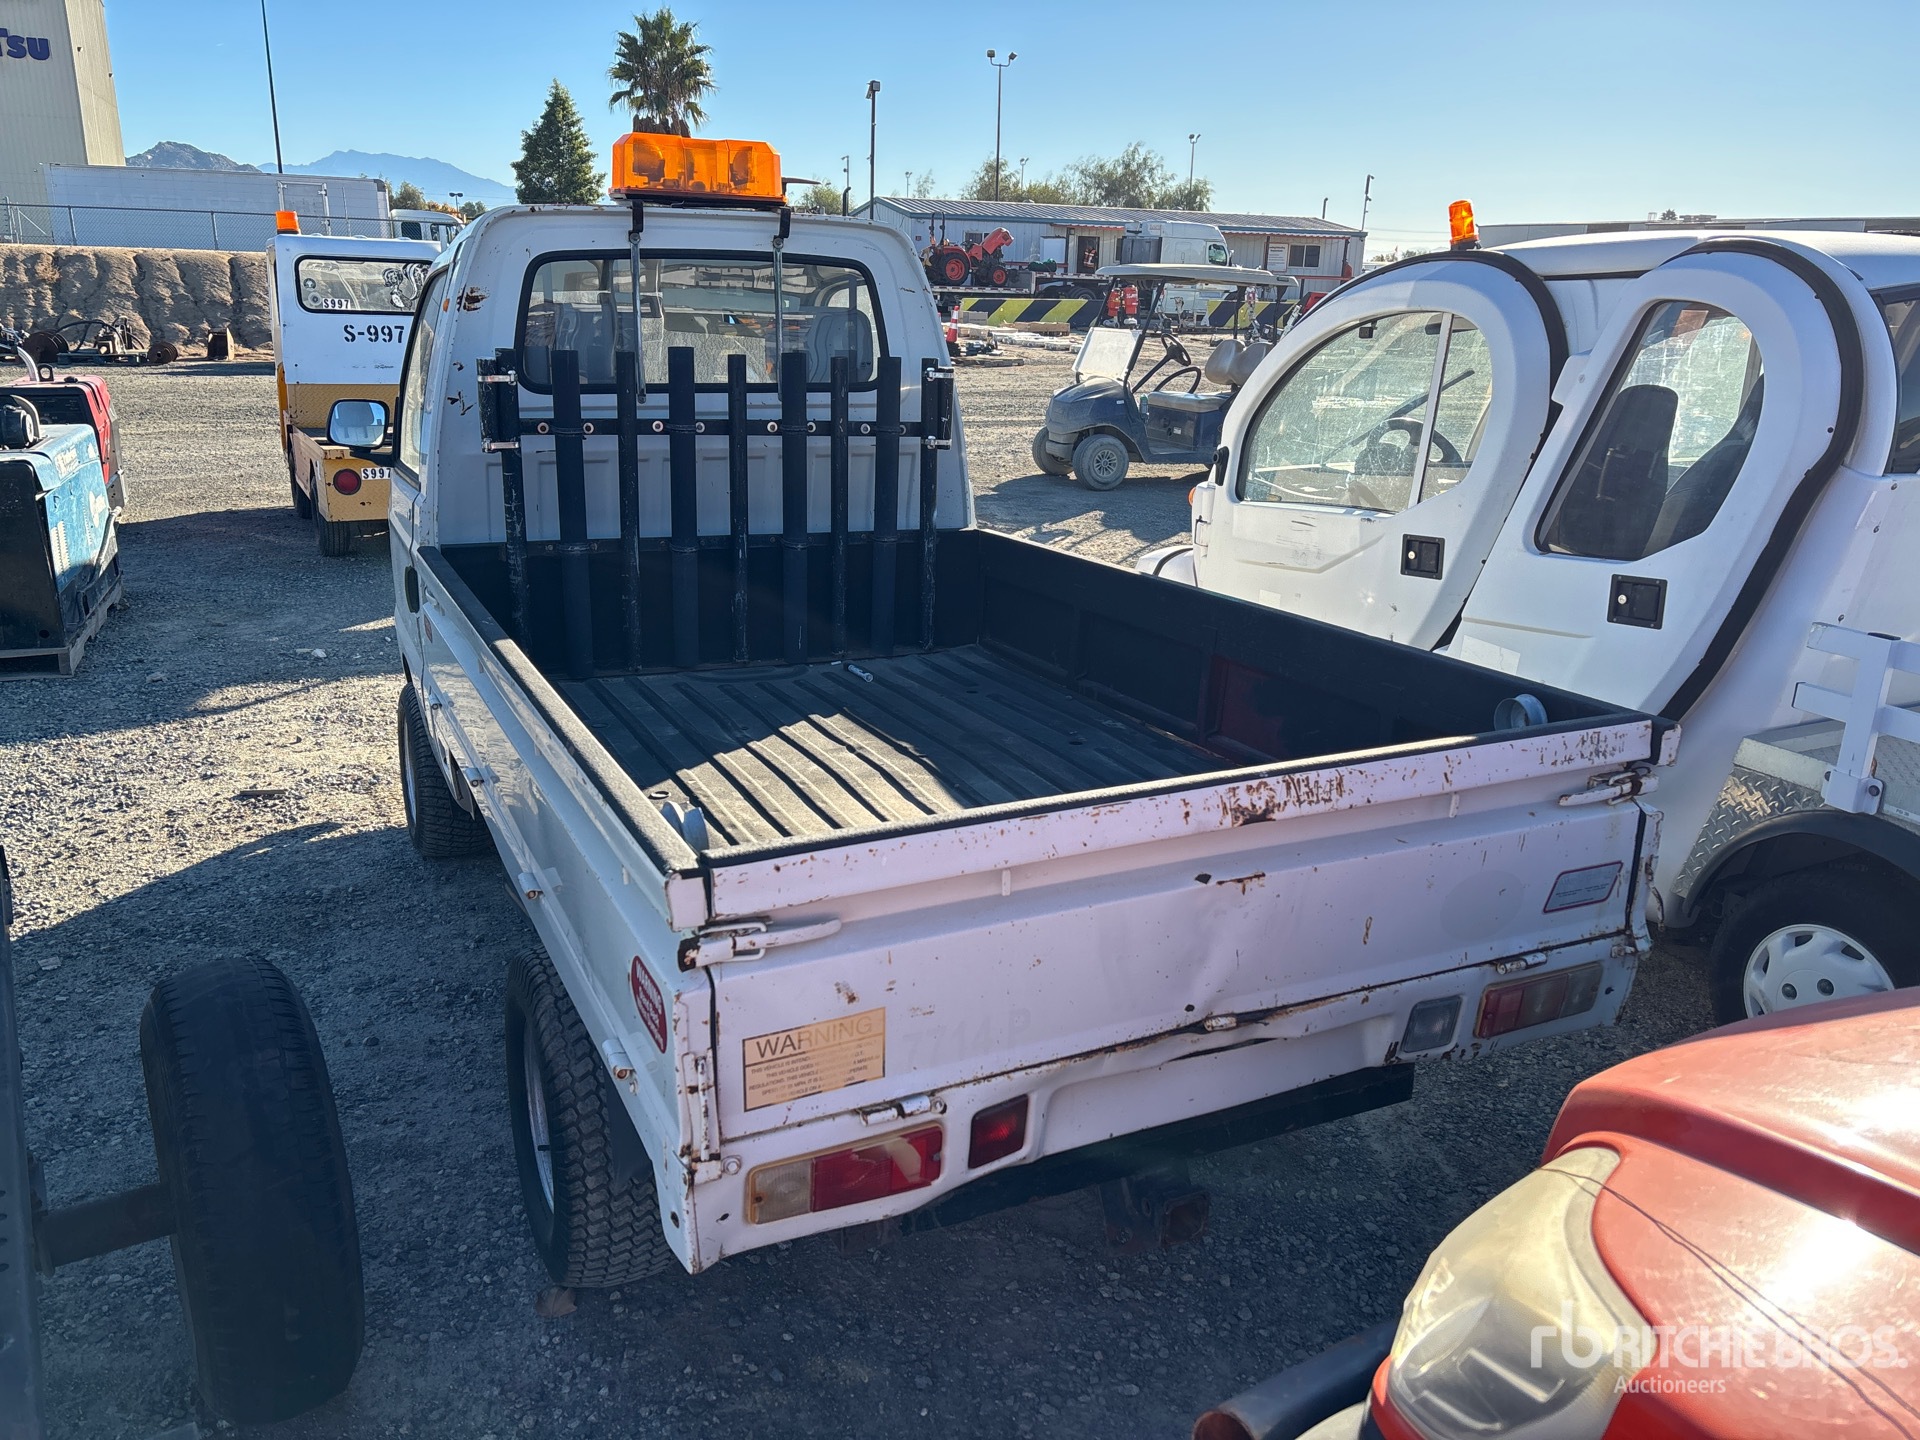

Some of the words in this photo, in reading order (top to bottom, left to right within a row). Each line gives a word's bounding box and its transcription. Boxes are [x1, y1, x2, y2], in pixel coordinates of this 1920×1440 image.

[323, 299, 350, 309] S997
[344, 324, 405, 343] S-997
[362, 467, 392, 479] S997
[756, 1016, 873, 1058] WARNING
